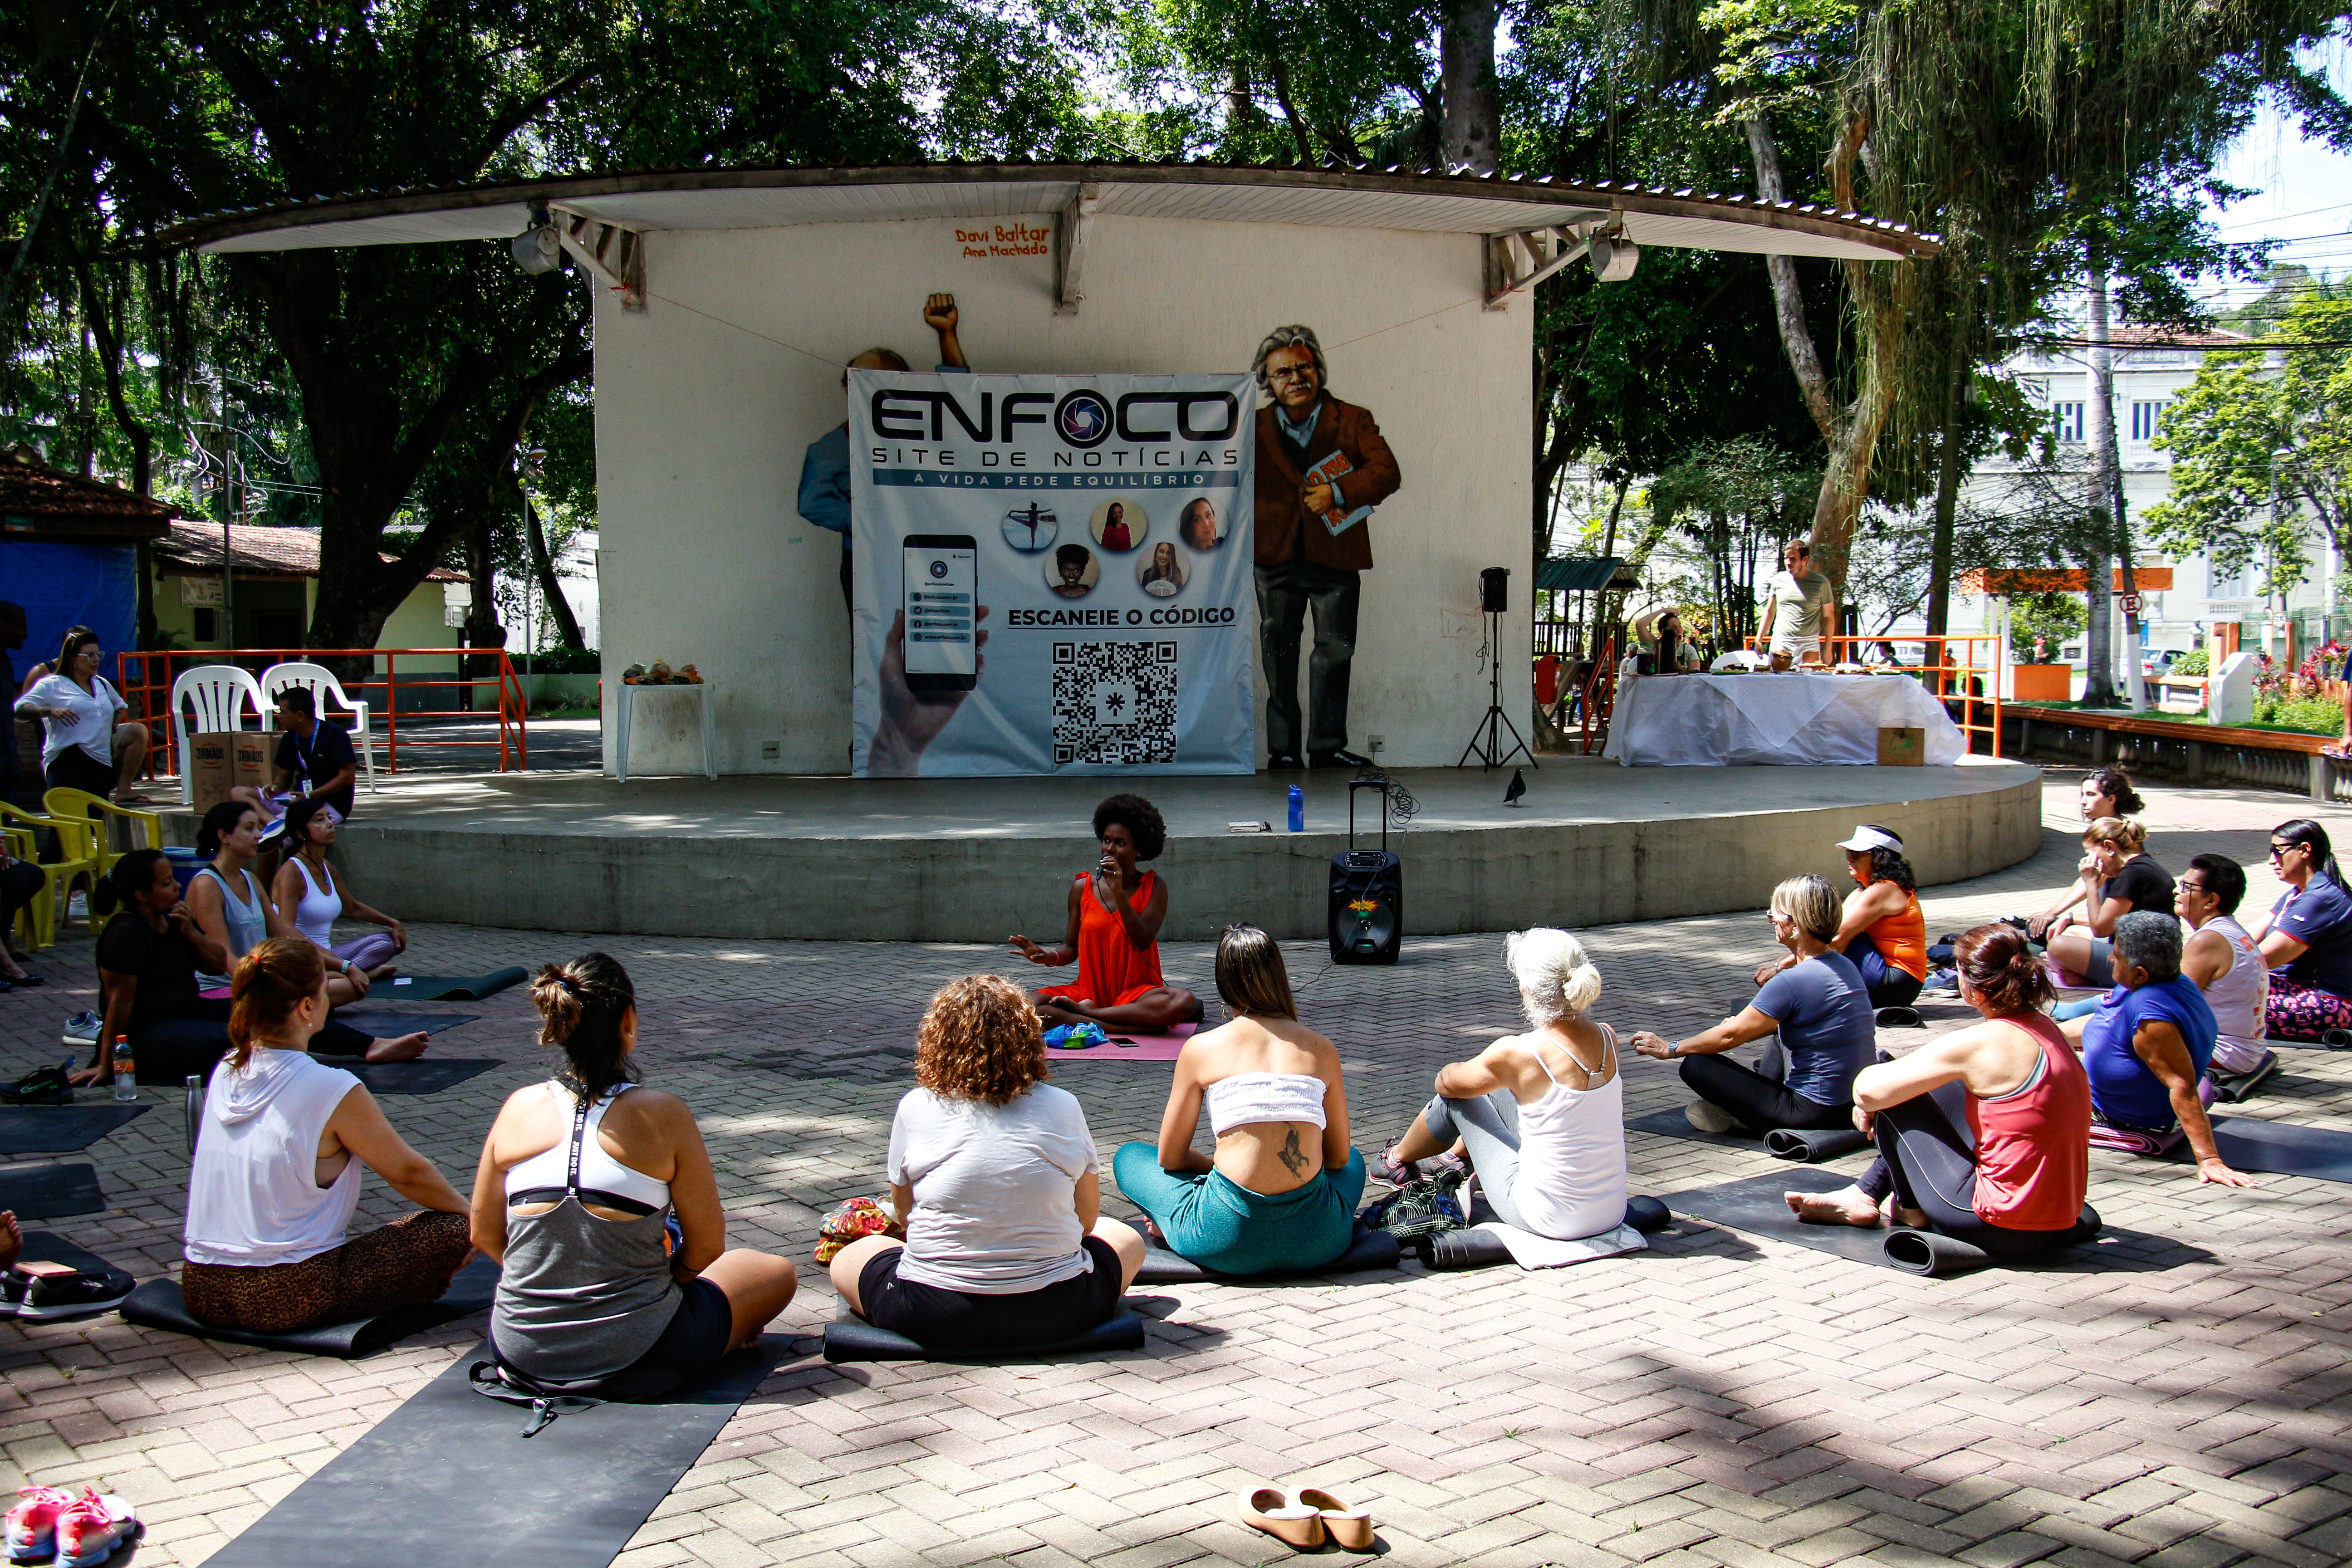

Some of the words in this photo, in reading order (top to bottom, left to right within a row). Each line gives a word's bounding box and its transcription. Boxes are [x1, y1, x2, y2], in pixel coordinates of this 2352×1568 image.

[955, 229, 989, 242] Davi
[995, 223, 1050, 242] Baltar
[962, 246, 987, 259] Ana
[989, 241, 1048, 257] Machado
[871, 389, 1239, 449] ENFOCO
[872, 447, 955, 466] SITE
[982, 451, 1026, 467] DE
[1054, 447, 1238, 467] NOTÍCIAS
[914, 473, 924, 483] A
[939, 474, 990, 485] VIDA
[1004, 476, 1058, 486] PEDE
[1073, 473, 1205, 485] EQUILÍBRIO
[1009, 608, 1120, 626] ESCANEIE
[1126, 609, 1143, 625] O
[1150, 604, 1236, 626] CÓDIGO
[577, 1113, 585, 1123] DO
[575, 1123, 583, 1132] IT.
[572, 1141, 580, 1156] JUST
[571, 1157, 578, 1167] DO
